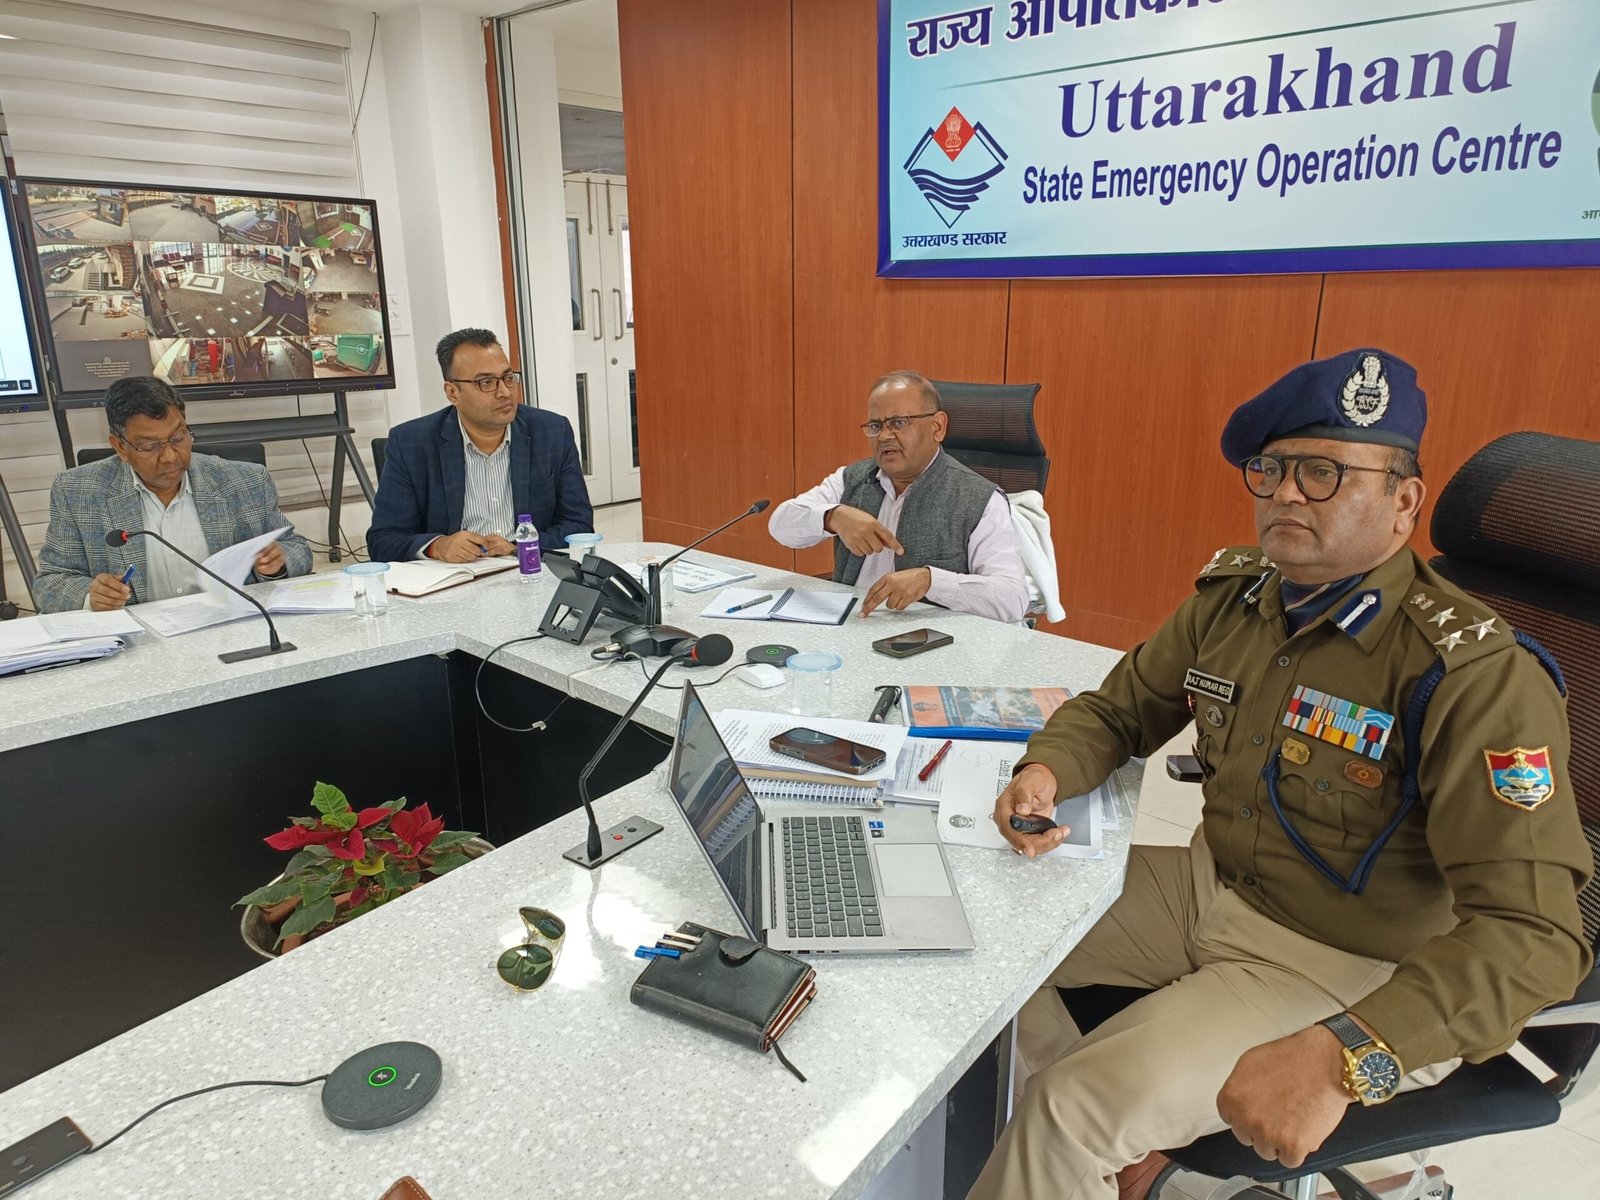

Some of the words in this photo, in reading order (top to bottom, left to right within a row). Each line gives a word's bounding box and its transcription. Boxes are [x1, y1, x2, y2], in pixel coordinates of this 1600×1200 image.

[907, 7, 993, 57] राज्य
[1059, 21, 1516, 138] Uttarakhand
[1022, 165, 1083, 204] State
[1091, 157, 1248, 206] Emergency
[1256, 134, 1419, 198] Operation
[1432, 122, 1562, 175] Centre
[961, 231, 1008, 246] सरकार
[1199, 678, 1219, 692] KUMAR
